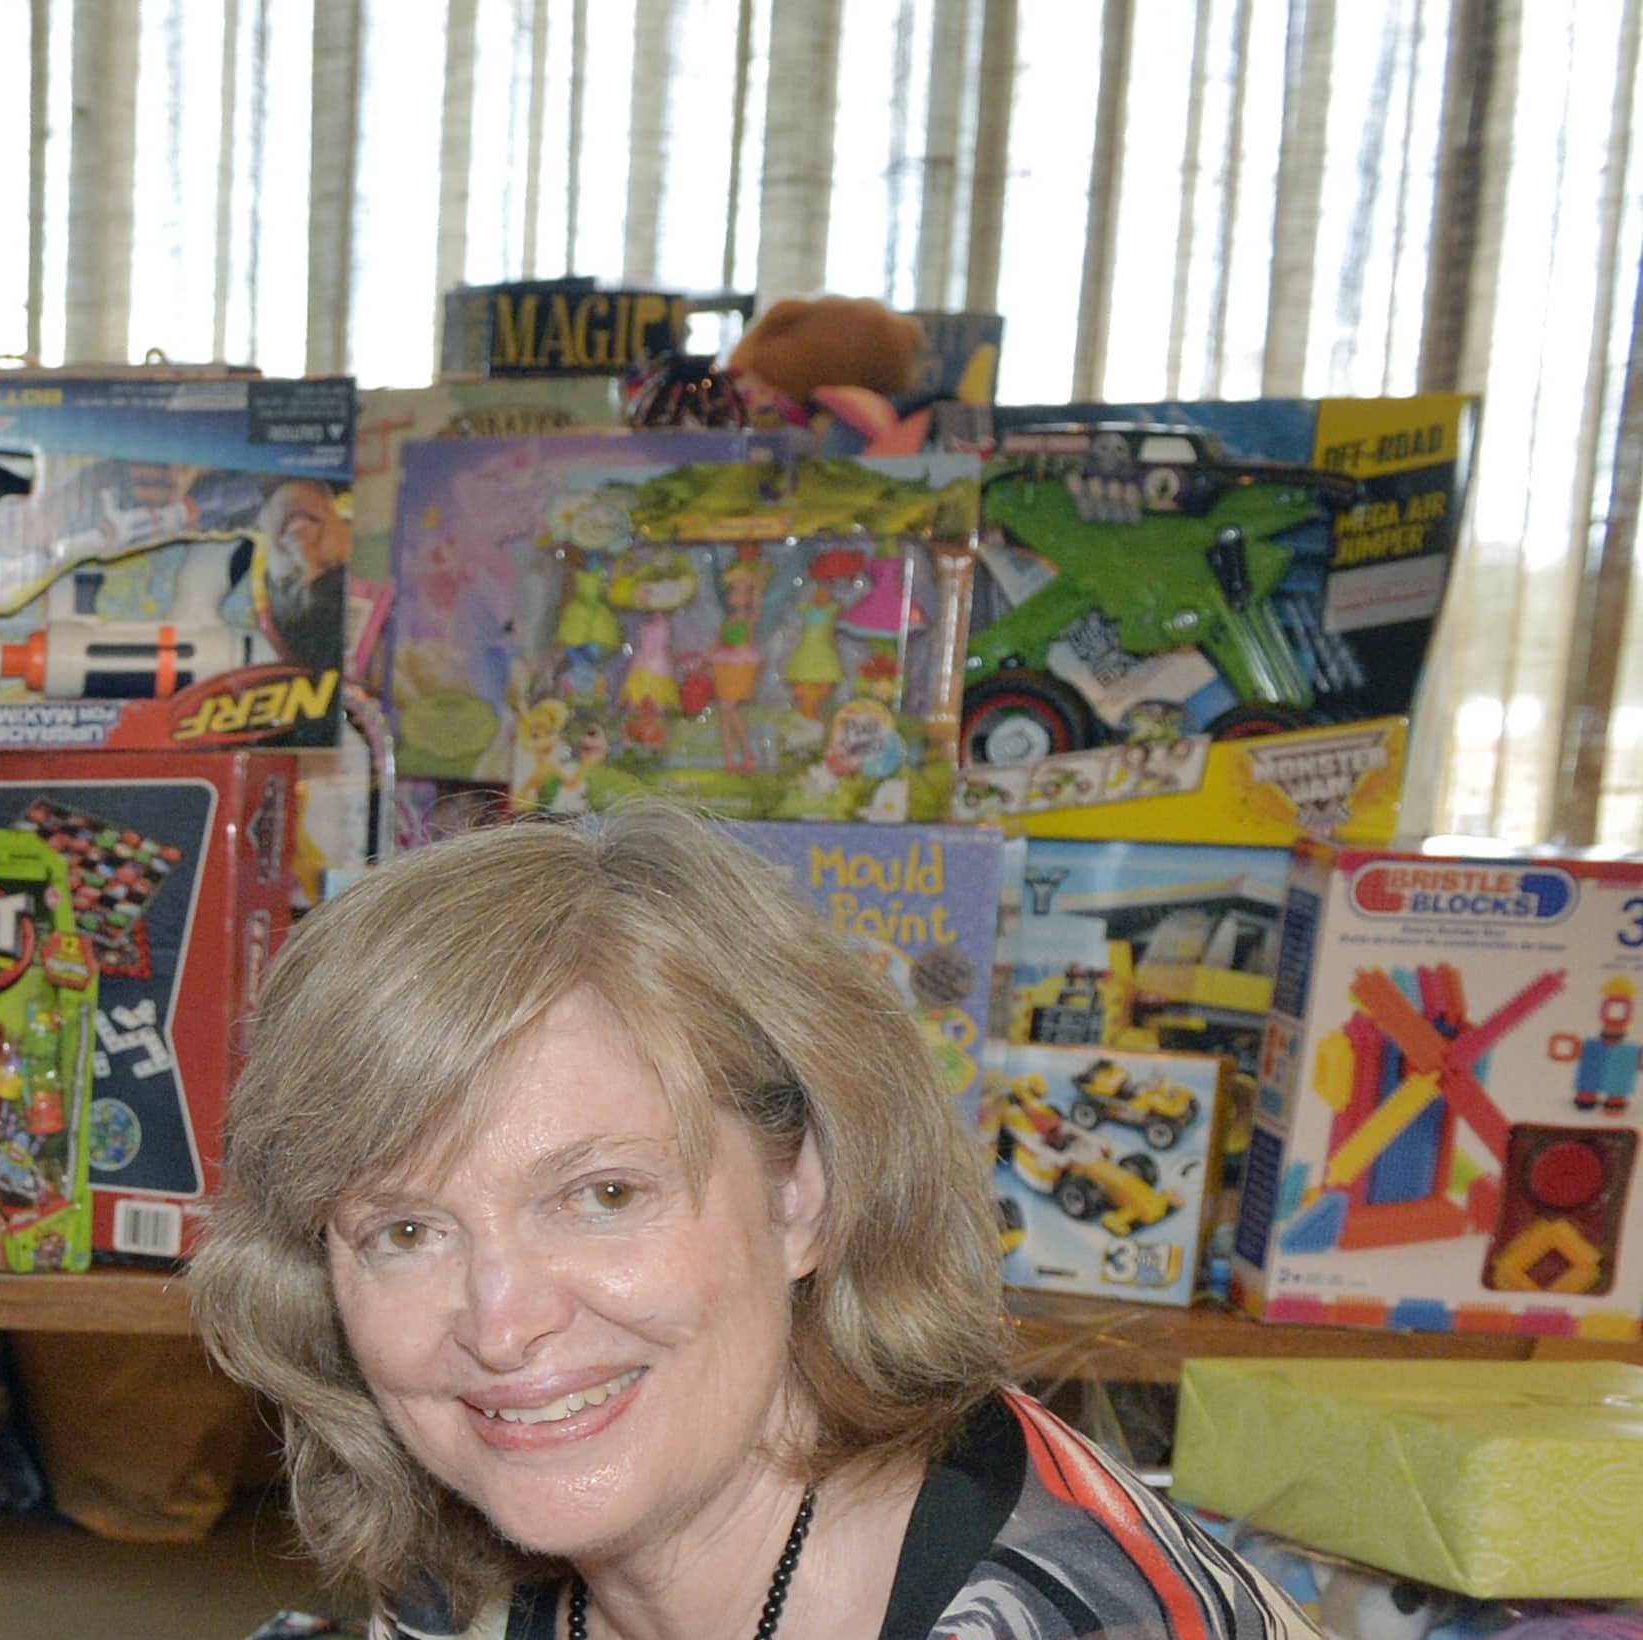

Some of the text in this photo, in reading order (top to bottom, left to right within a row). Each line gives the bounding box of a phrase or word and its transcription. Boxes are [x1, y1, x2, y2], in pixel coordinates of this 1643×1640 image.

[174, 670, 339, 740] NERF
[809, 840, 946, 896] Mould
[830, 893, 957, 944] Paint
[1412, 892, 1531, 917] BLOCKS
